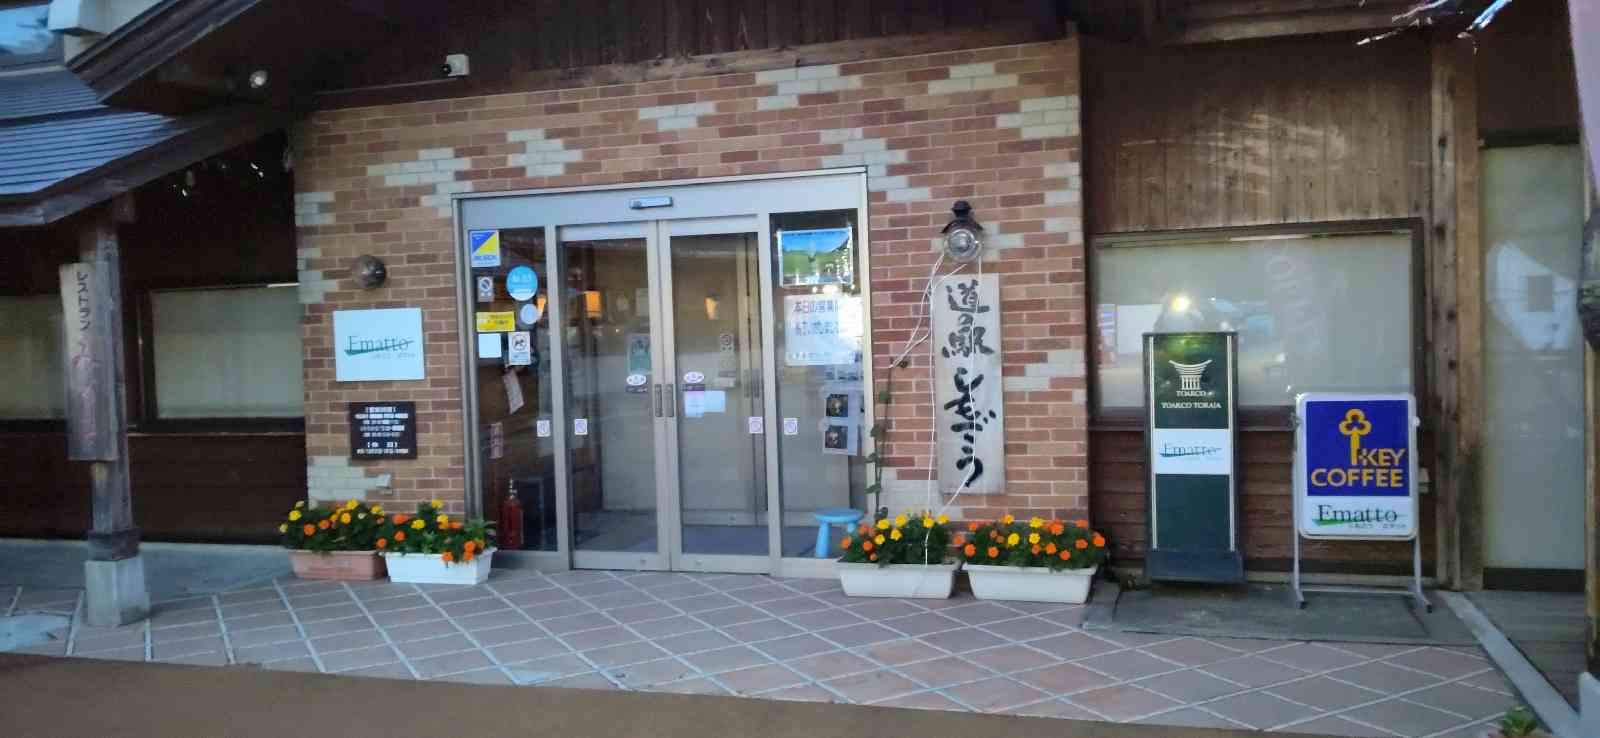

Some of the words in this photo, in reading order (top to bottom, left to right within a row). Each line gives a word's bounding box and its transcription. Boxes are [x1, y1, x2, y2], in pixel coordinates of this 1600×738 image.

[76, 271, 90, 332] レストラン
[346, 335, 409, 353] Ematto
[1359, 448, 1406, 467] KEY
[1311, 467, 1403, 488] COFFEE
[1317, 504, 1398, 523] Ematto
